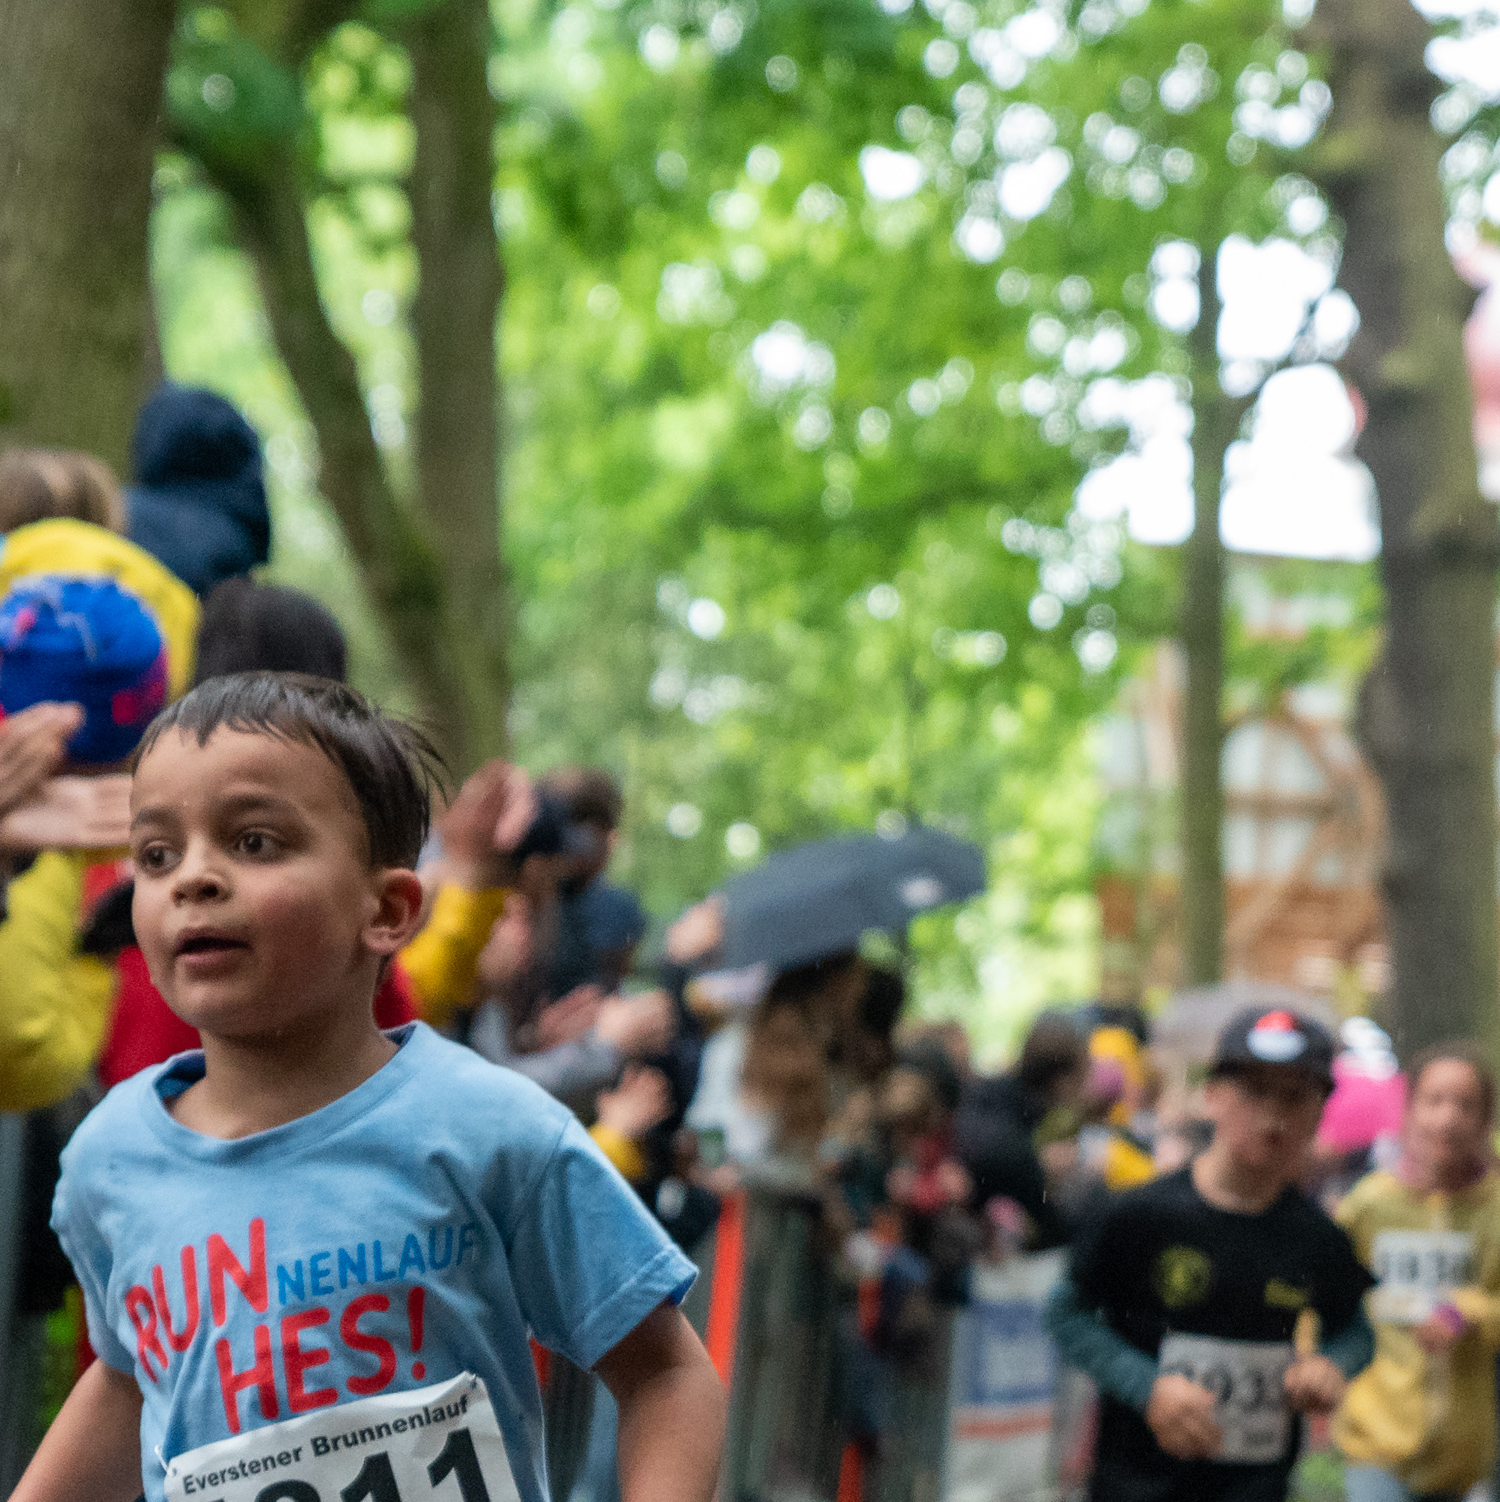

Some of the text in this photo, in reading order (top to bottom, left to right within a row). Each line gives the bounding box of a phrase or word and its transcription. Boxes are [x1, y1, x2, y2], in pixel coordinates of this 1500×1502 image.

[125, 1217, 269, 1383] RUN
[215, 1285, 426, 1434] HES!
[182, 1396, 471, 1495] Everstener Brunnenlauf
